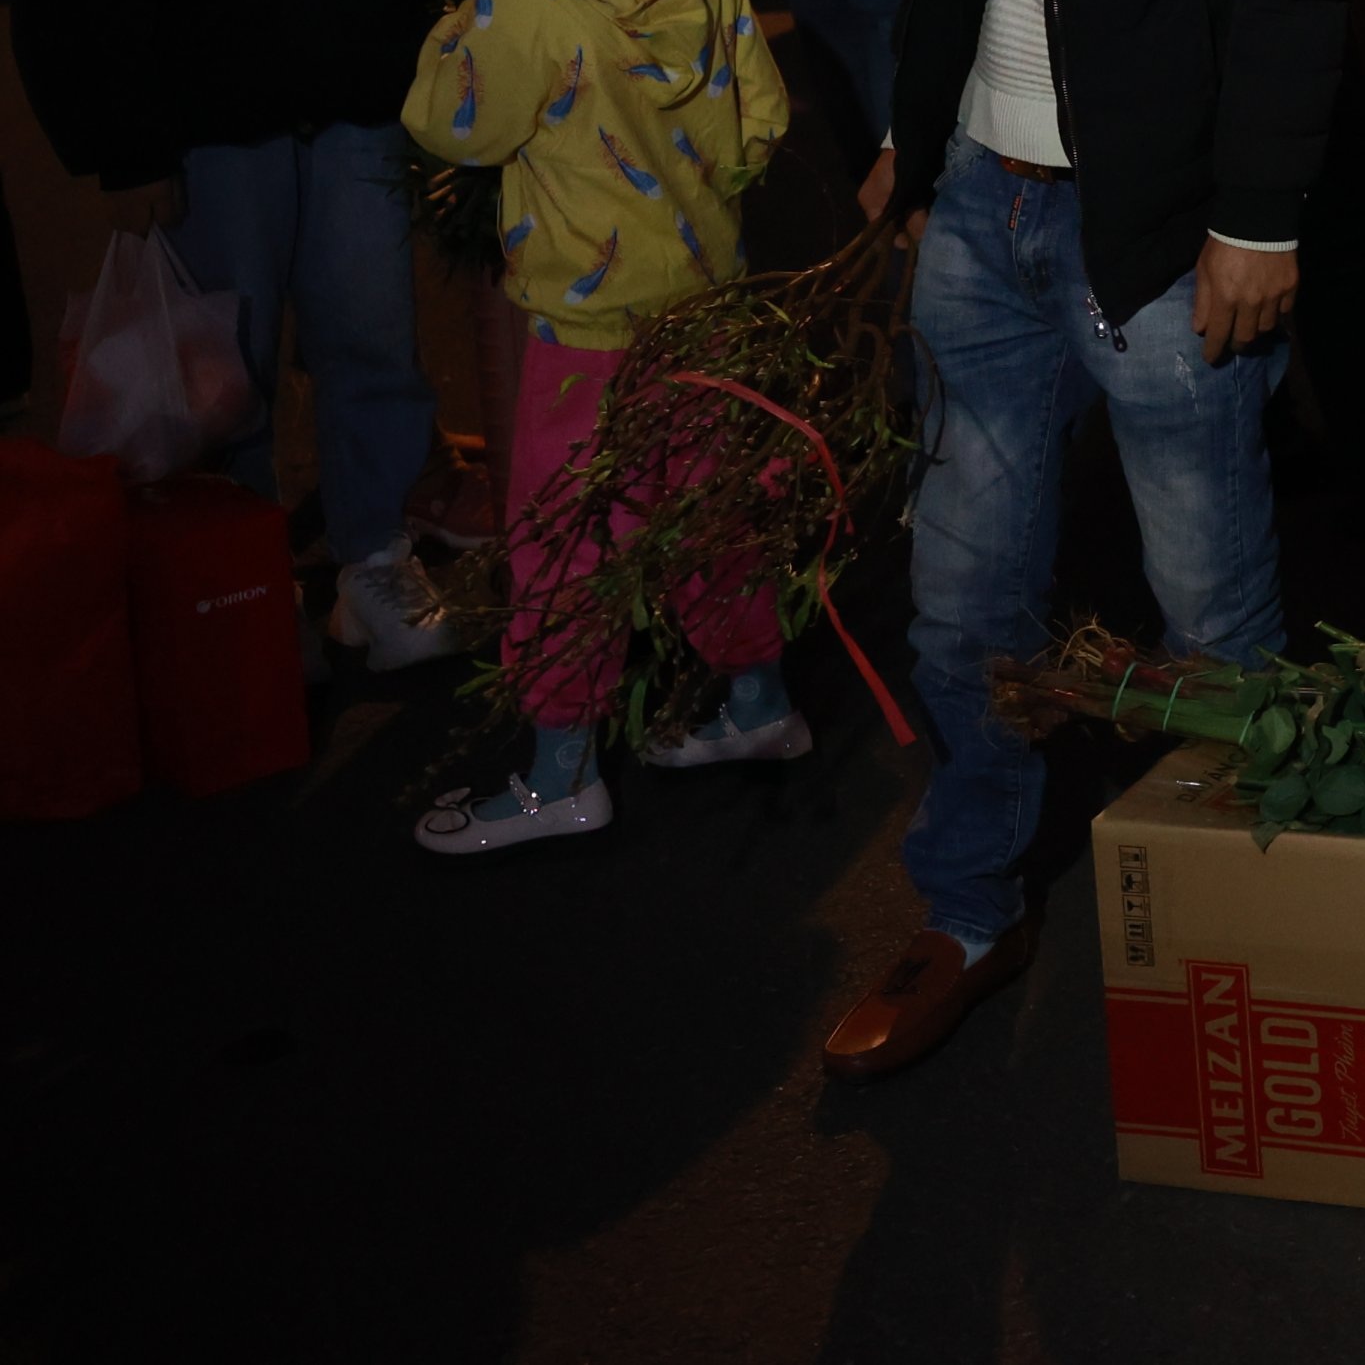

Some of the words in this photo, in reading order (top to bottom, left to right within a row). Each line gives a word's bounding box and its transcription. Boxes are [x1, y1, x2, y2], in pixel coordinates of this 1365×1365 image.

[215, 585, 267, 609] ORION
[1200, 971, 1248, 1166] MEIZAN
[1260, 1016, 1324, 1138] GOLD
